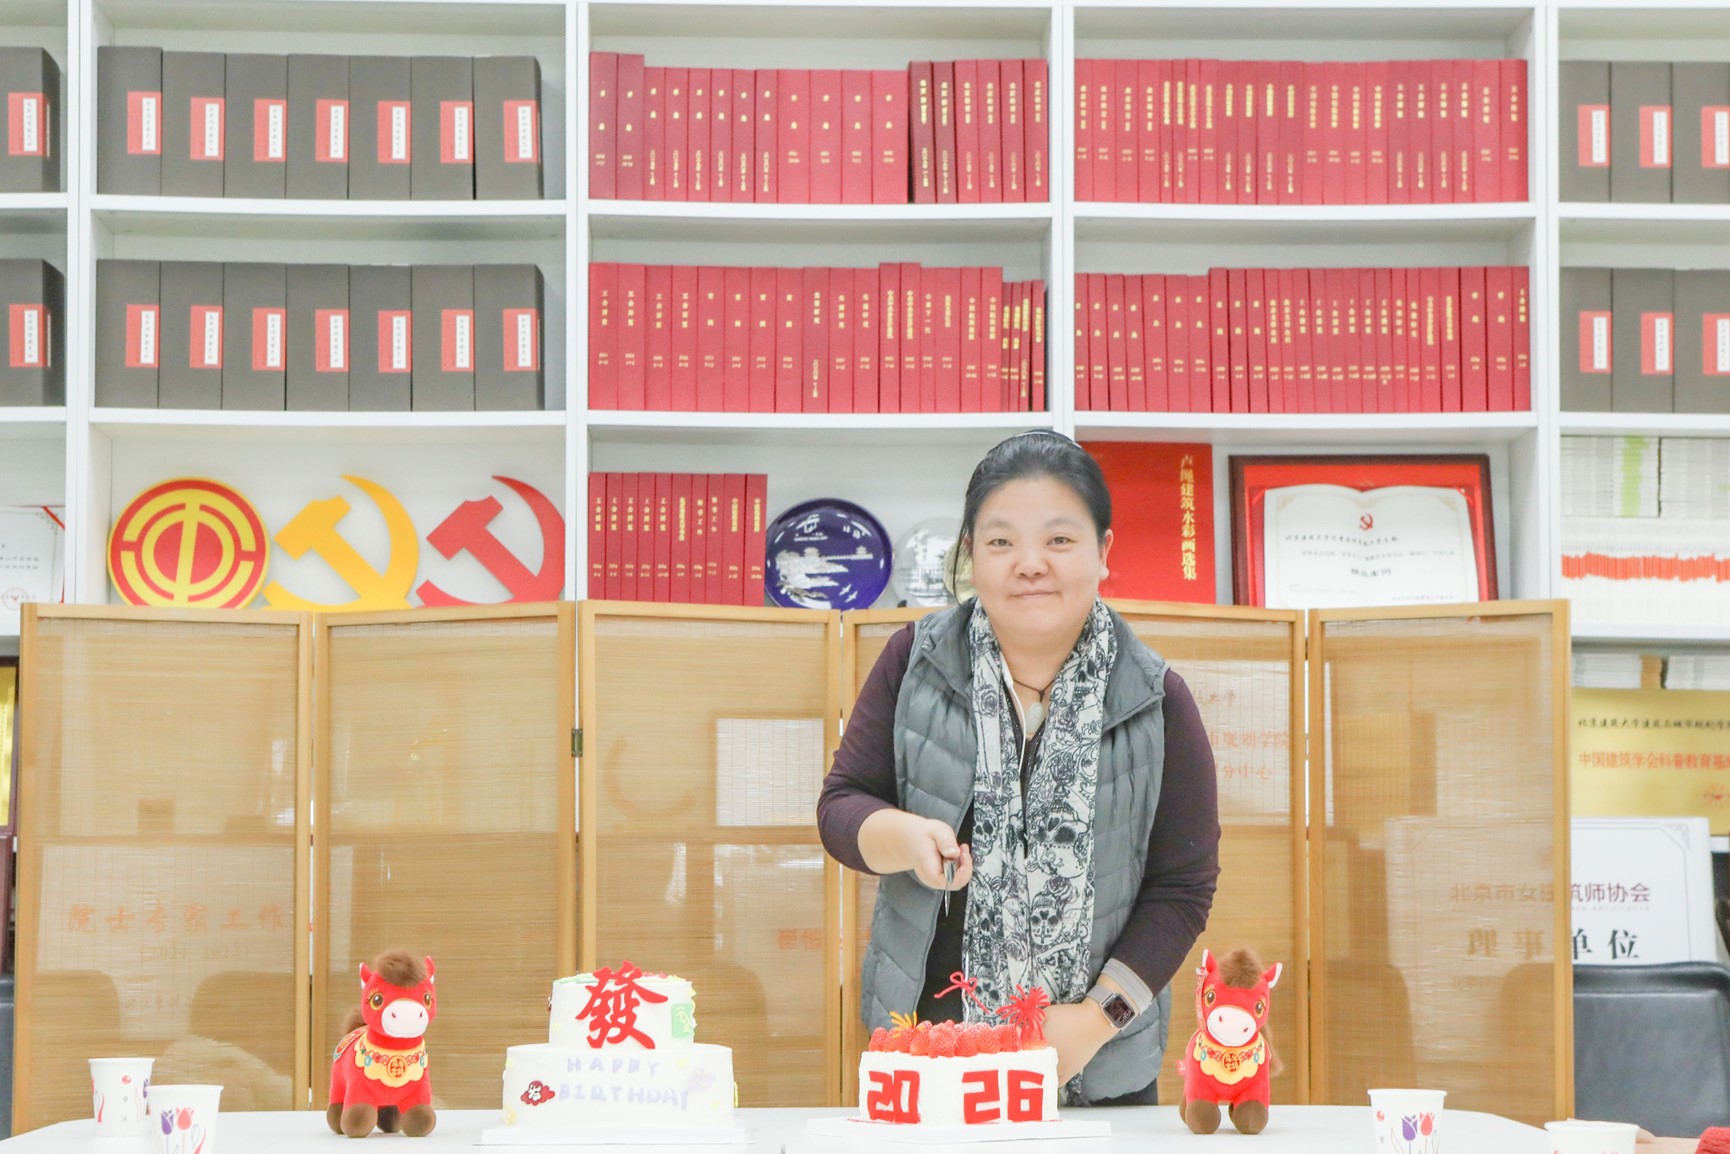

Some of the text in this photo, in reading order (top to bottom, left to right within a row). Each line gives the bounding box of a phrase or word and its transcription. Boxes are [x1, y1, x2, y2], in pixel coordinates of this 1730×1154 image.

[1579, 751, 1730, 770] 中国建筑学会科普教育基
[566, 1057, 659, 1077] HAPPY
[558, 1083, 689, 1111] BIRTHDAY
